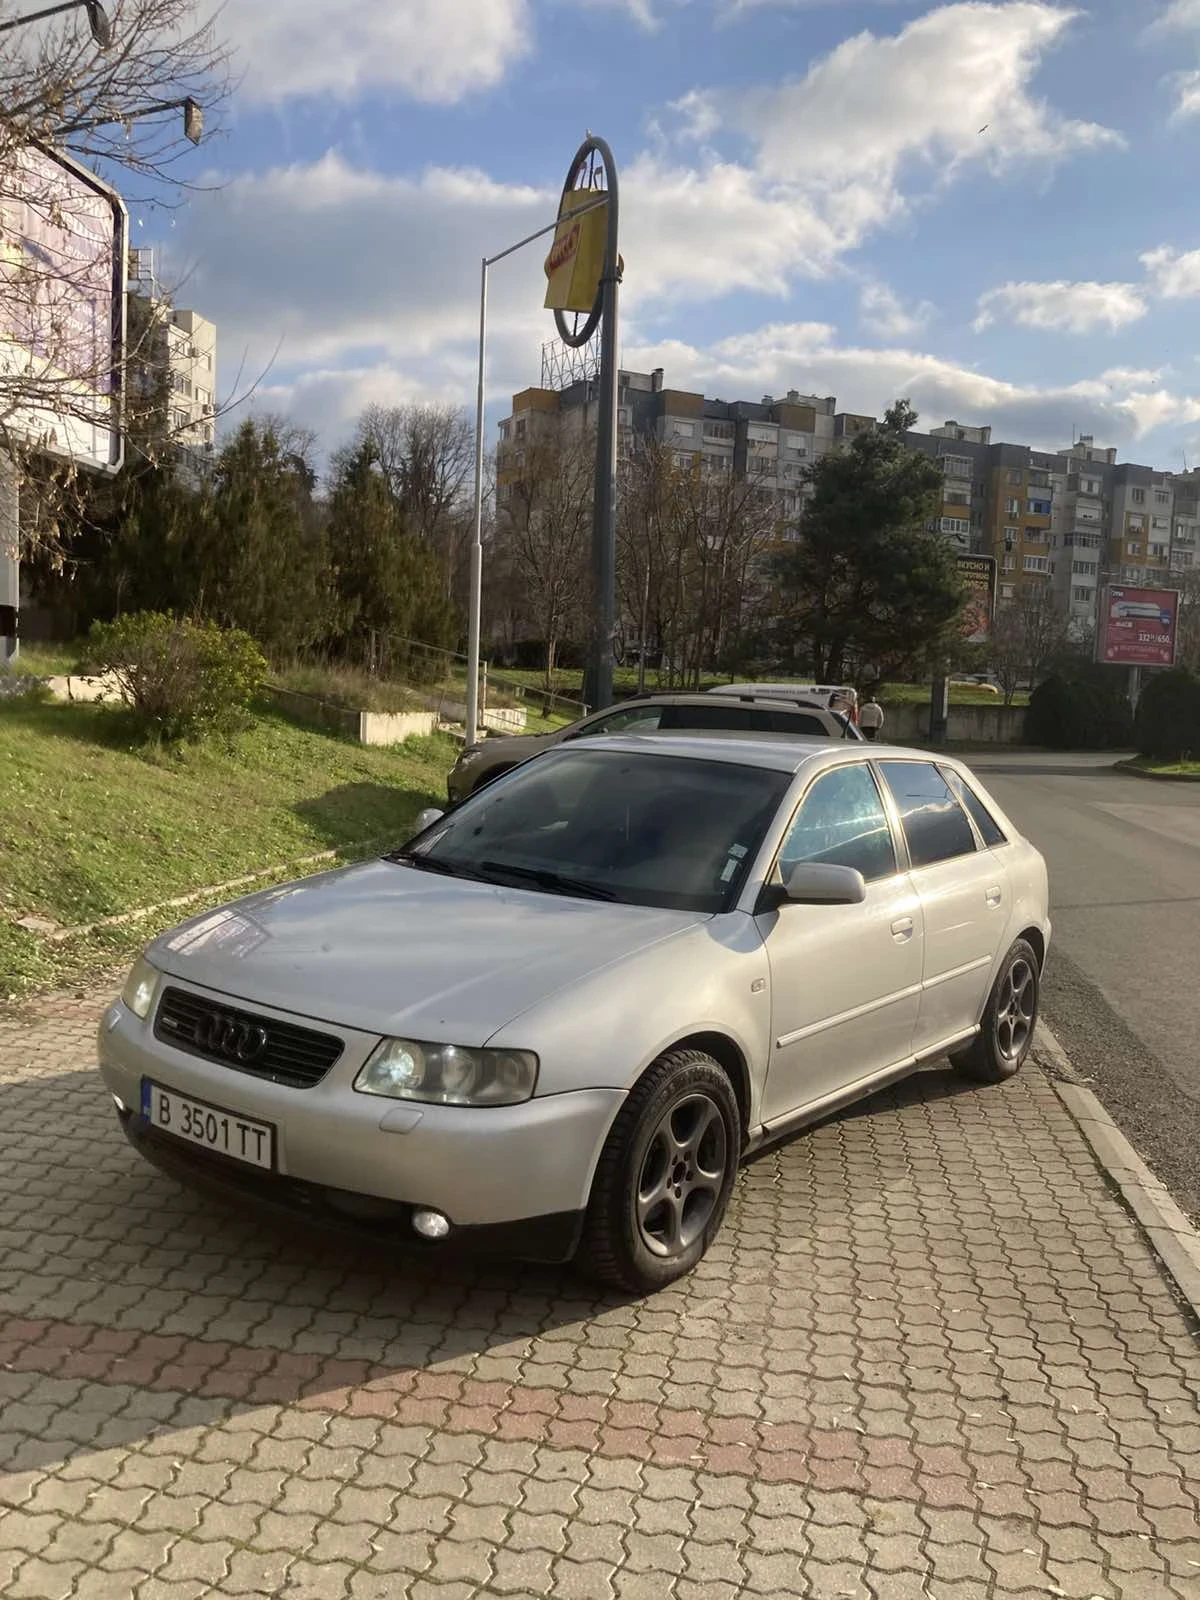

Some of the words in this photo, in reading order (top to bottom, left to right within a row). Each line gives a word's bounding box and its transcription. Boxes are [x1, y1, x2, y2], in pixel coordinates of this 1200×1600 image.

[159, 1094, 171, 1126] B
[180, 1103, 229, 1150] 3501
[236, 1122, 266, 1161] TT
